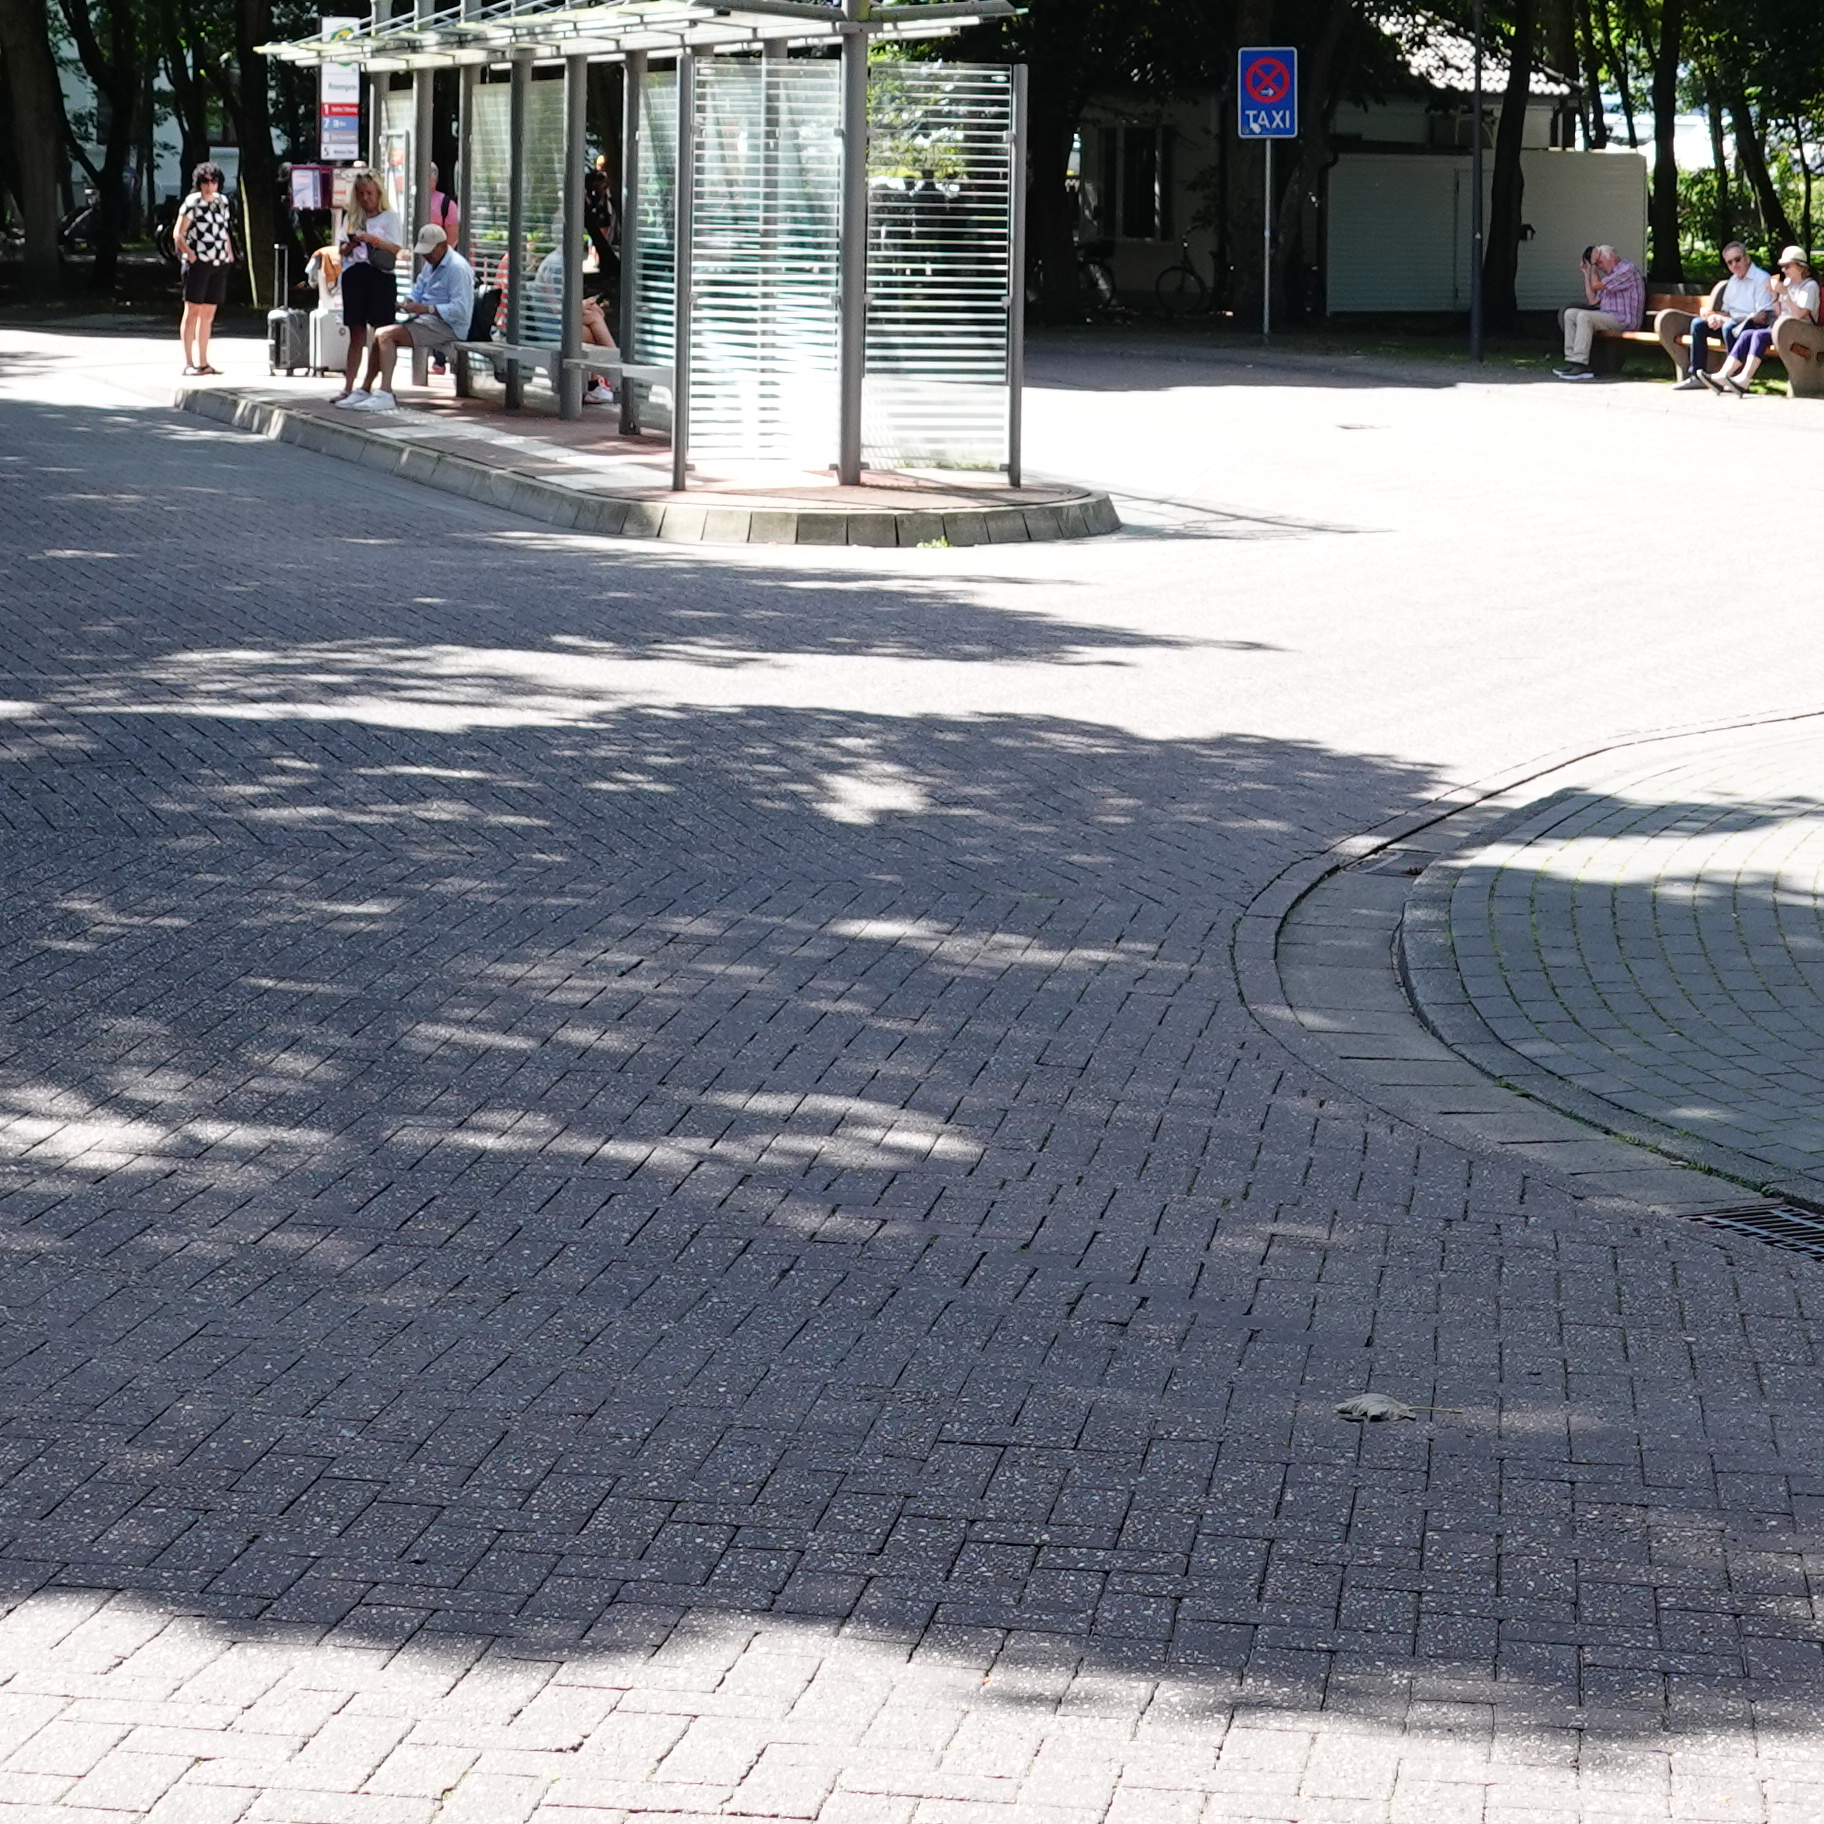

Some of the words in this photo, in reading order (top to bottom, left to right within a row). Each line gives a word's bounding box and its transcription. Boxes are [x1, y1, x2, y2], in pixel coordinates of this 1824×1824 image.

[323, 104, 329, 115] 1
[323, 118, 330, 129] 7
[1245, 109, 1290, 129] TAXI
